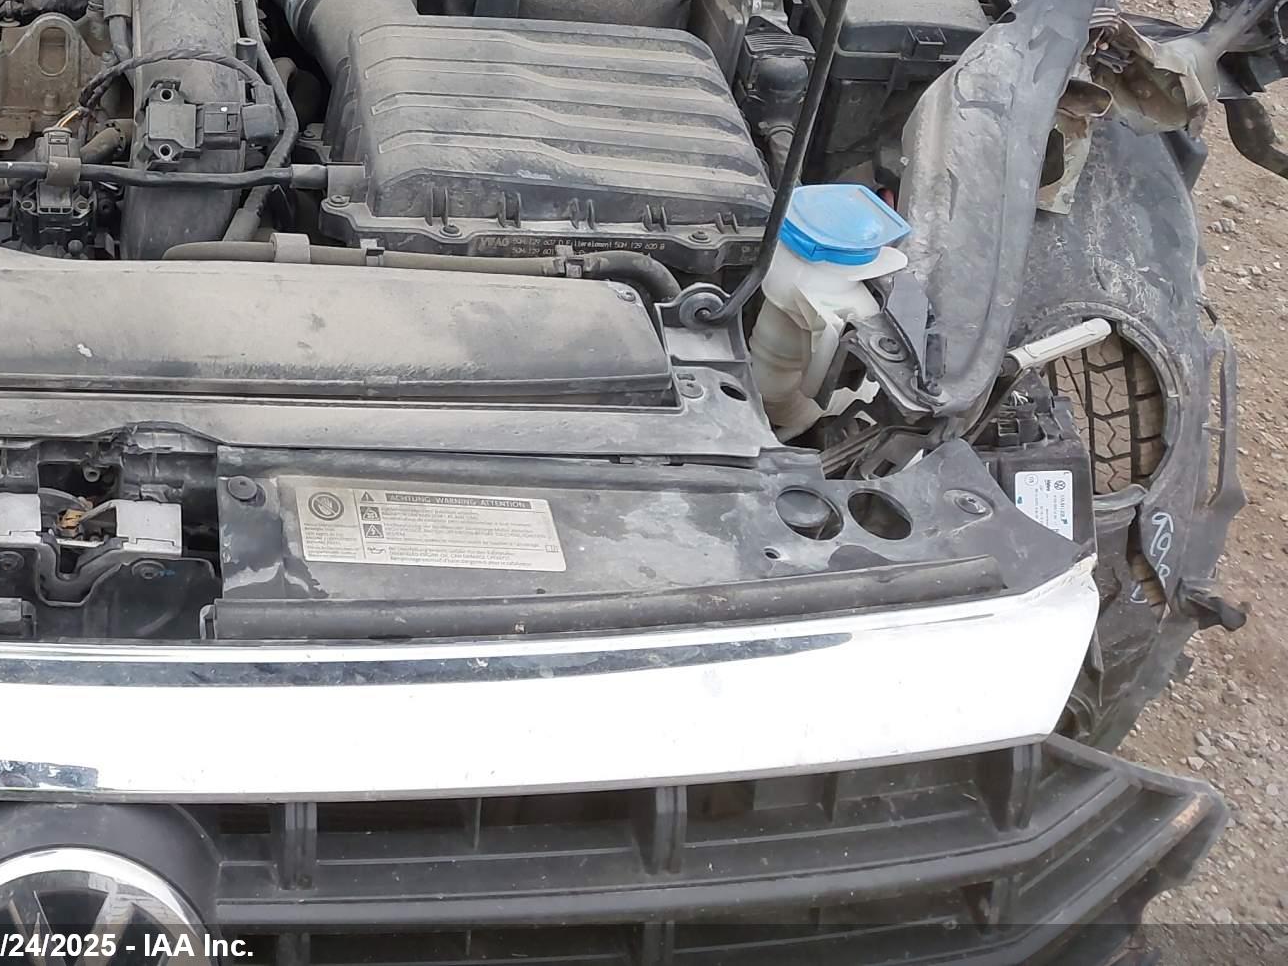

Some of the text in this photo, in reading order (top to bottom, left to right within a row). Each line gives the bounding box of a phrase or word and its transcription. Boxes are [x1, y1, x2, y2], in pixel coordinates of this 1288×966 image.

[389, 493, 526, 509] ACHTUNG WARNING ATTENTION
